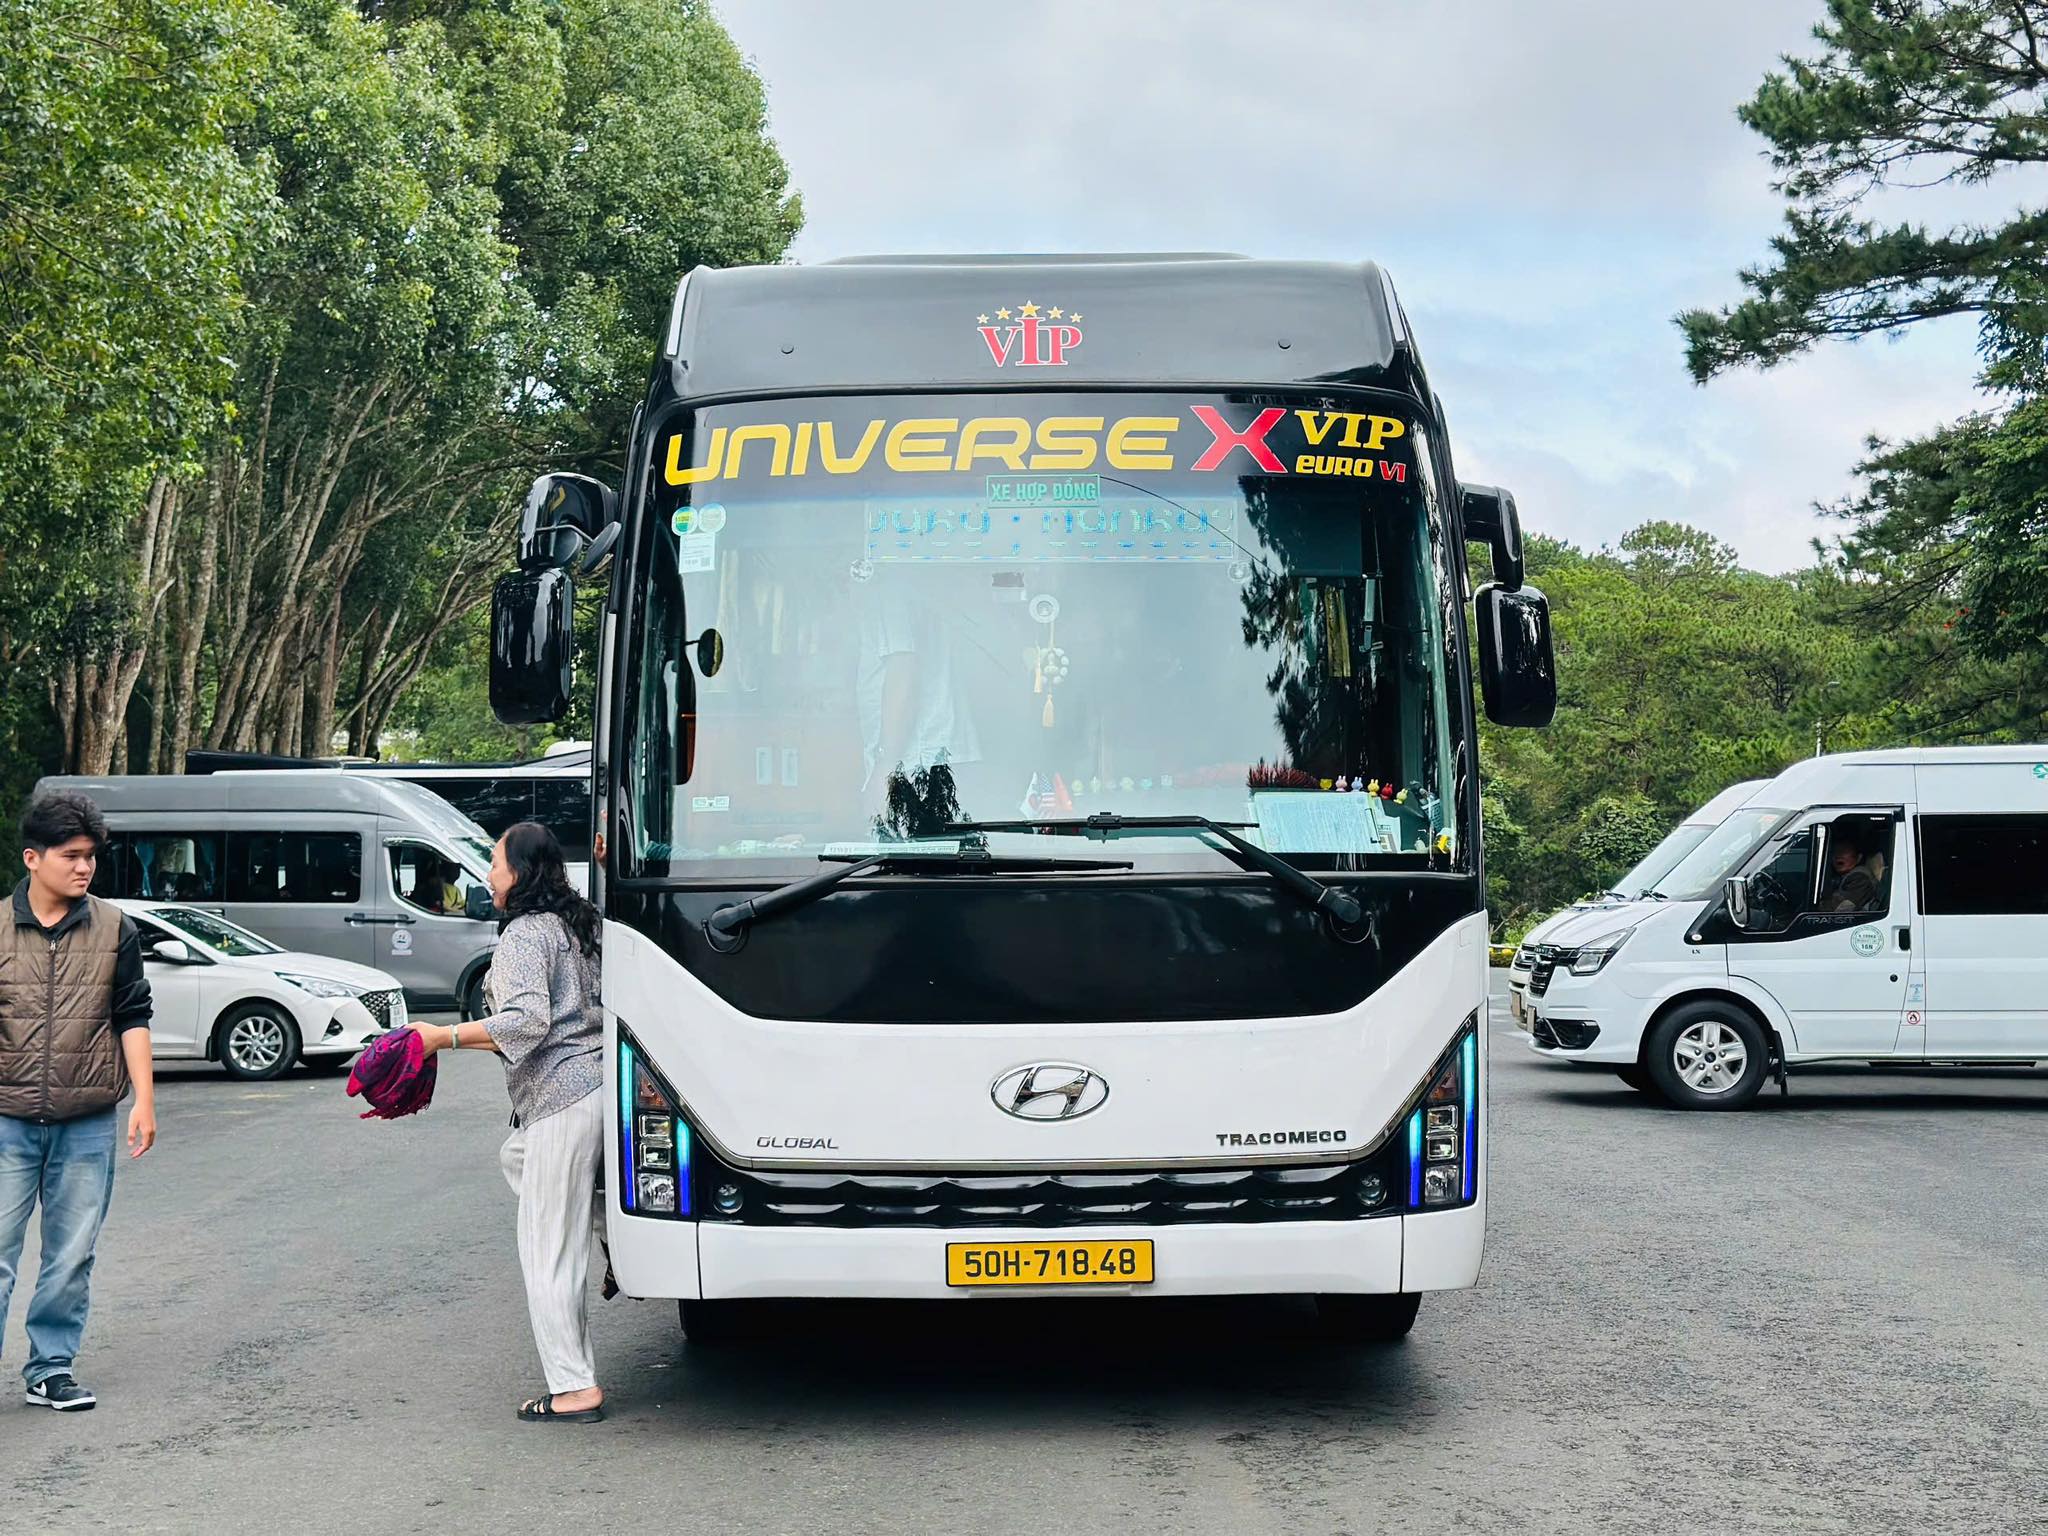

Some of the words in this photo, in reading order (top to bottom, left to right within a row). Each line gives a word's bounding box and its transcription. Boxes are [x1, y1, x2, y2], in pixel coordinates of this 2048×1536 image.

[977, 316, 1083, 367] VIP
[664, 416, 1180, 486] UNIVERSE
[1189, 405, 1289, 474] X
[1294, 409, 1405, 450] VIP
[1379, 460, 1407, 483] VI
[991, 483, 1010, 500] XE
[756, 1135, 839, 1149] GLOBAL
[1216, 1130, 1347, 1146] TRACOMECO
[965, 1247, 1136, 1277] 50H-718.48
